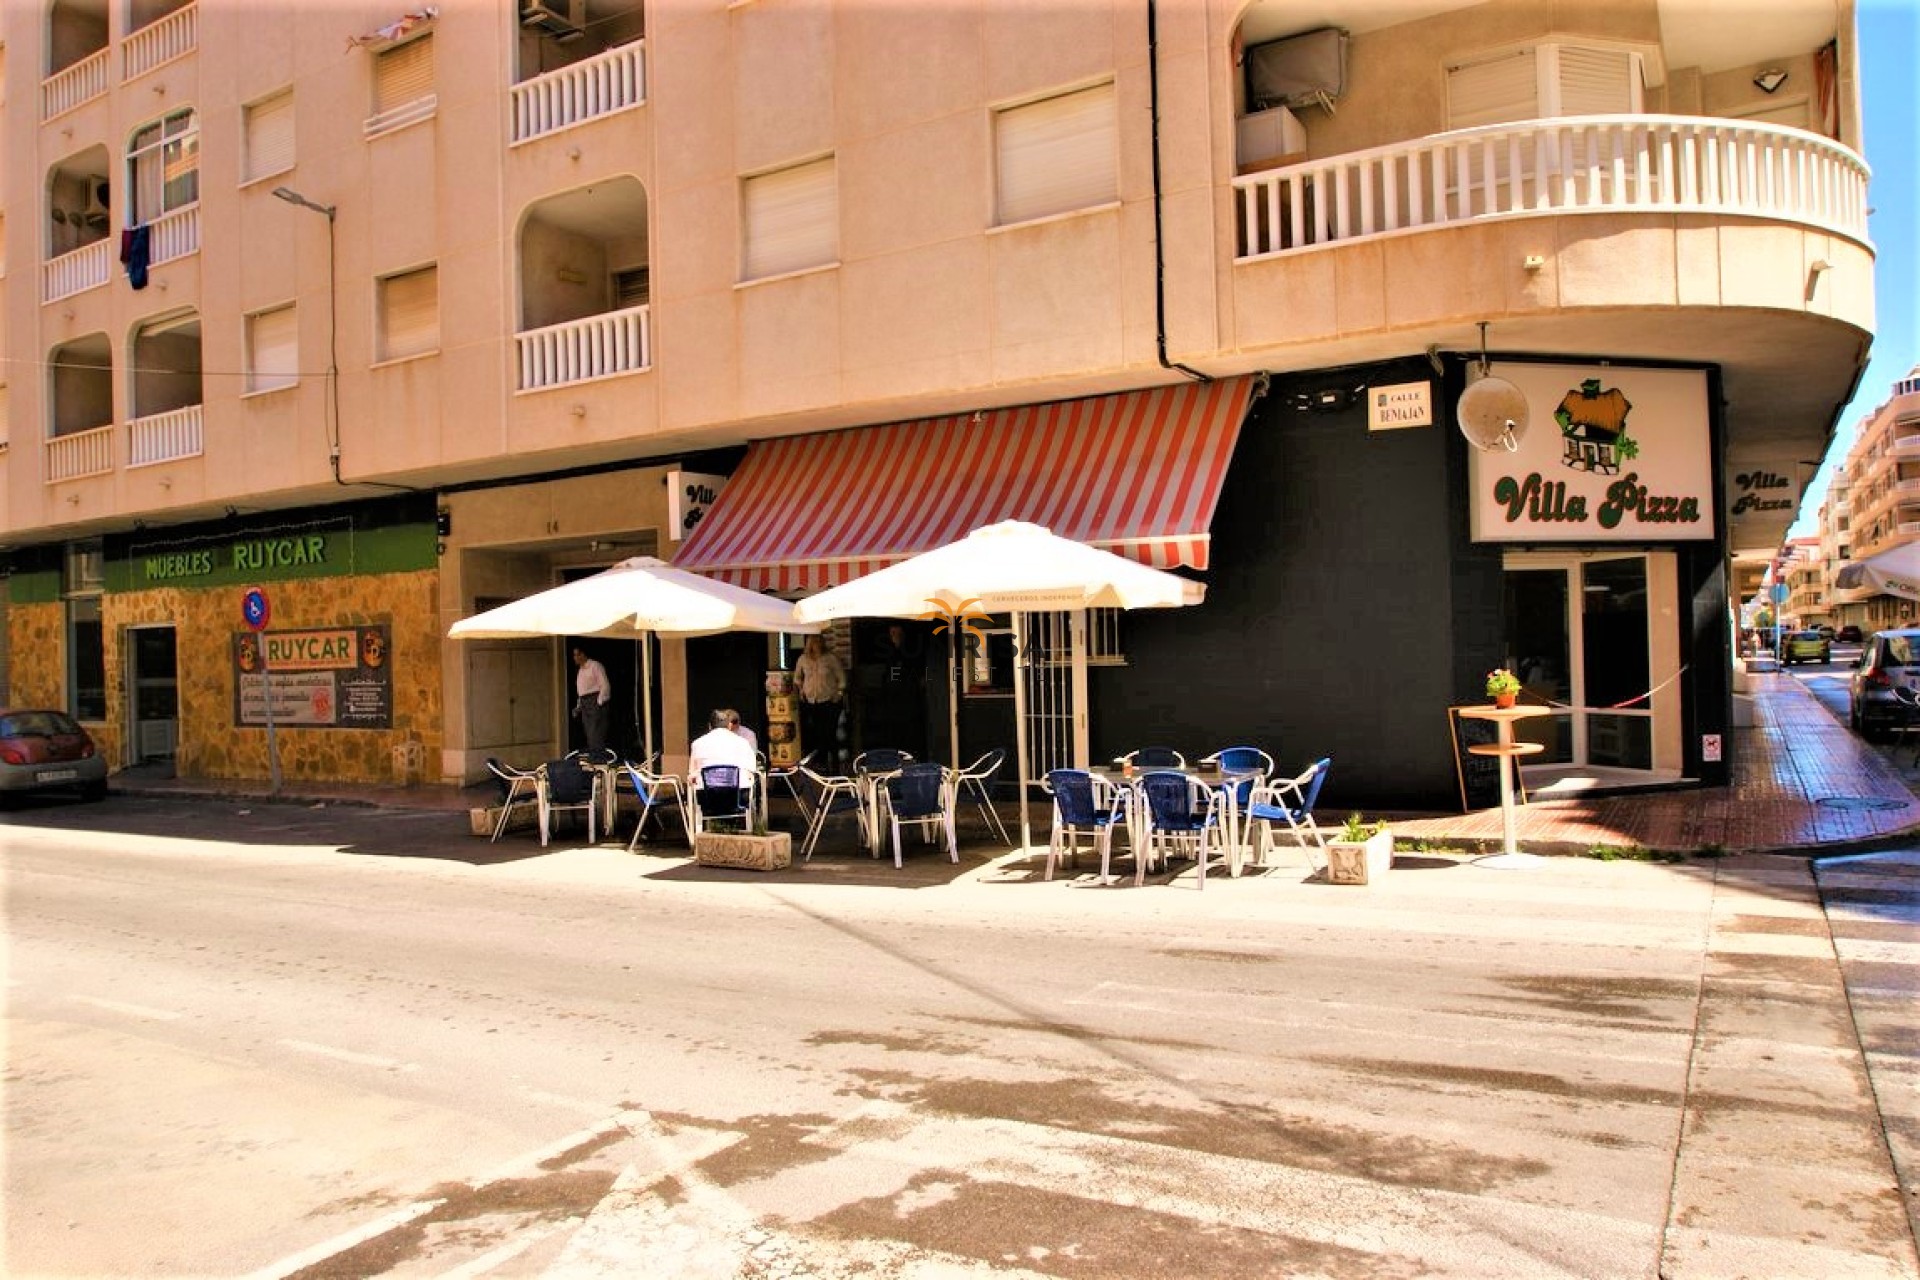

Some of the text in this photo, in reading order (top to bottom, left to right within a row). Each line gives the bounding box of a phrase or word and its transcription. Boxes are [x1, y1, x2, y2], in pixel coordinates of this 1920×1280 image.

[1391, 391, 1421, 403] CALLE
[1735, 471, 1789, 491] Villa
[1494, 472, 1699, 529] Villa Pizza
[1731, 490, 1793, 515] Pizza
[546, 521, 560, 534] 14
[145, 536, 325, 579] MUEBLES RUYCAR
[268, 637, 350, 659] RUYCAR
